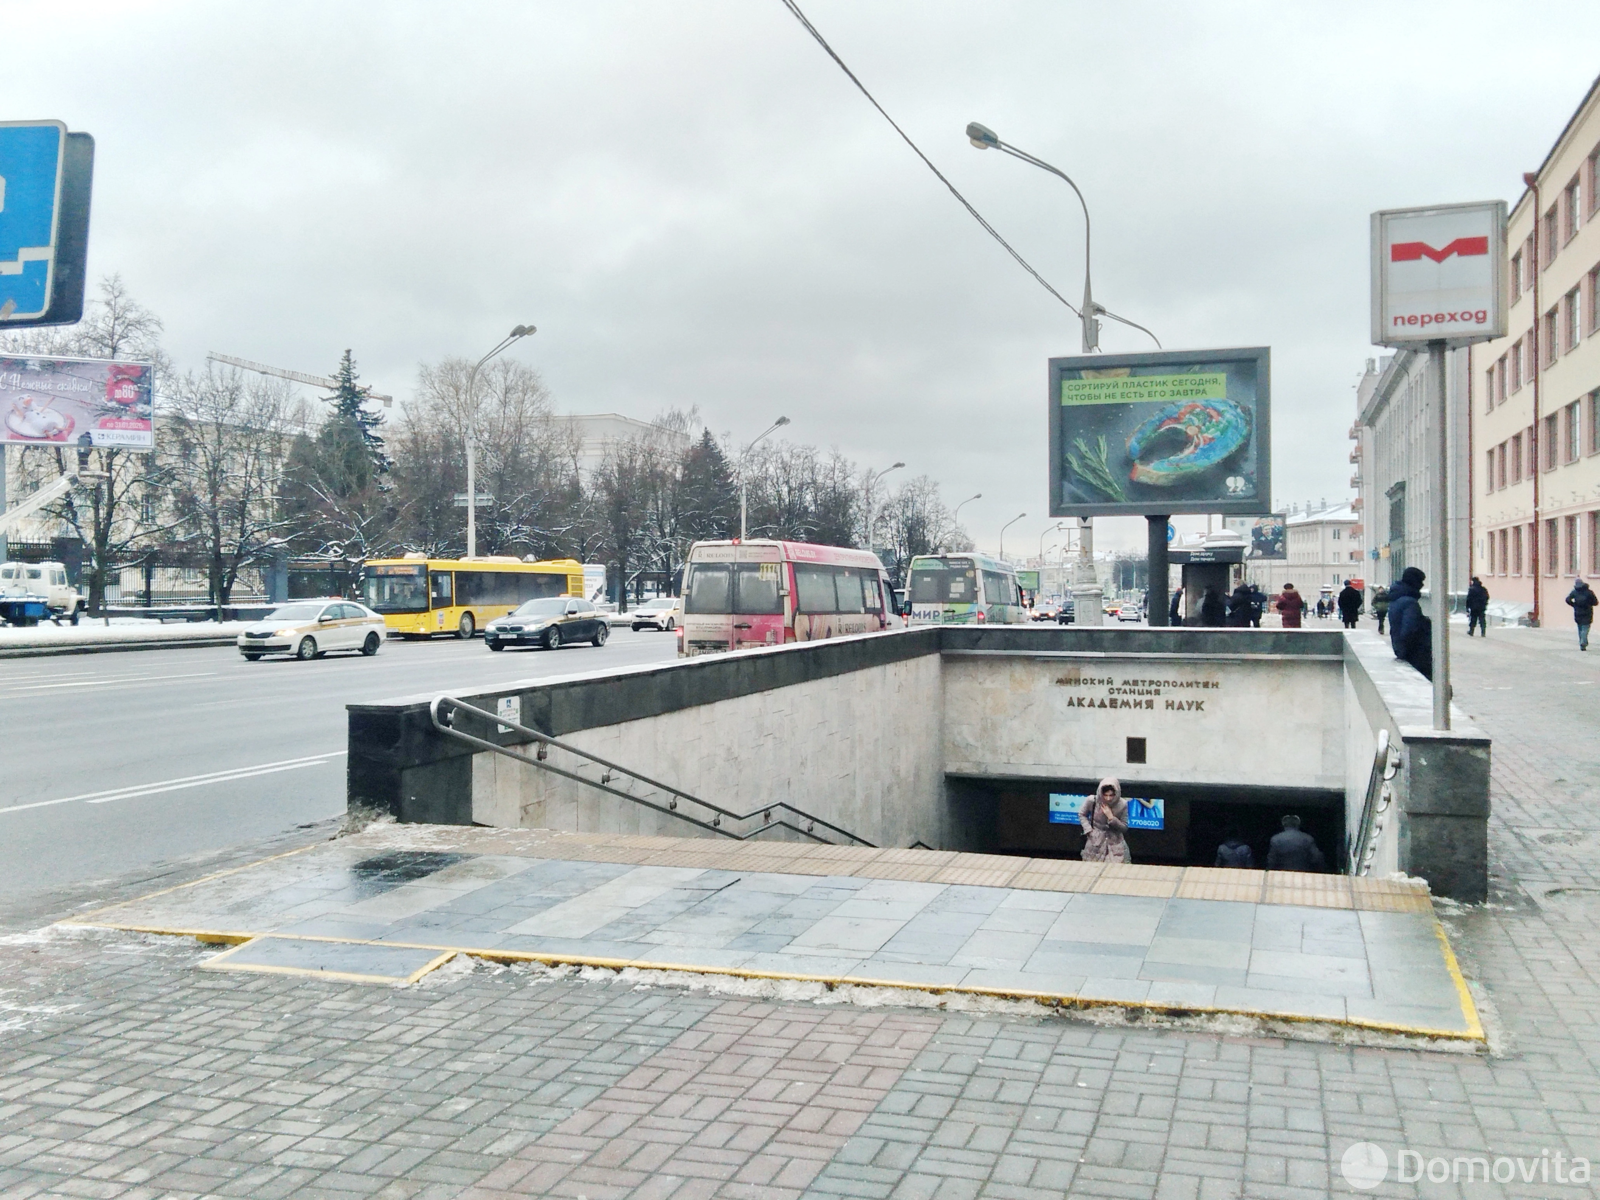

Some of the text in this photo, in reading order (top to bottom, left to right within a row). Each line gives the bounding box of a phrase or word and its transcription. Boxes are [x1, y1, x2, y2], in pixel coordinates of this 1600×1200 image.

[1393, 309, 1487, 328] переход
[1067, 377, 1221, 391] СОРТИРУЙ ПЛАСТИК СЕГОДНЯ,
[1067, 388, 1207, 401] ЧТОБЫ НЕ ЕСТЬ ЕГО ЗАВТРА
[106, 433, 145, 441] КЕРАМИН
[912, 610, 940, 619] МИР
[1055, 677, 1220, 689] МИНСКИЙ МЕТРОПОЛИТЕН
[1108, 687, 1161, 696] СТАНЦИЯ
[1066, 696, 1205, 711] АКАДЕМИЯ НАУК
